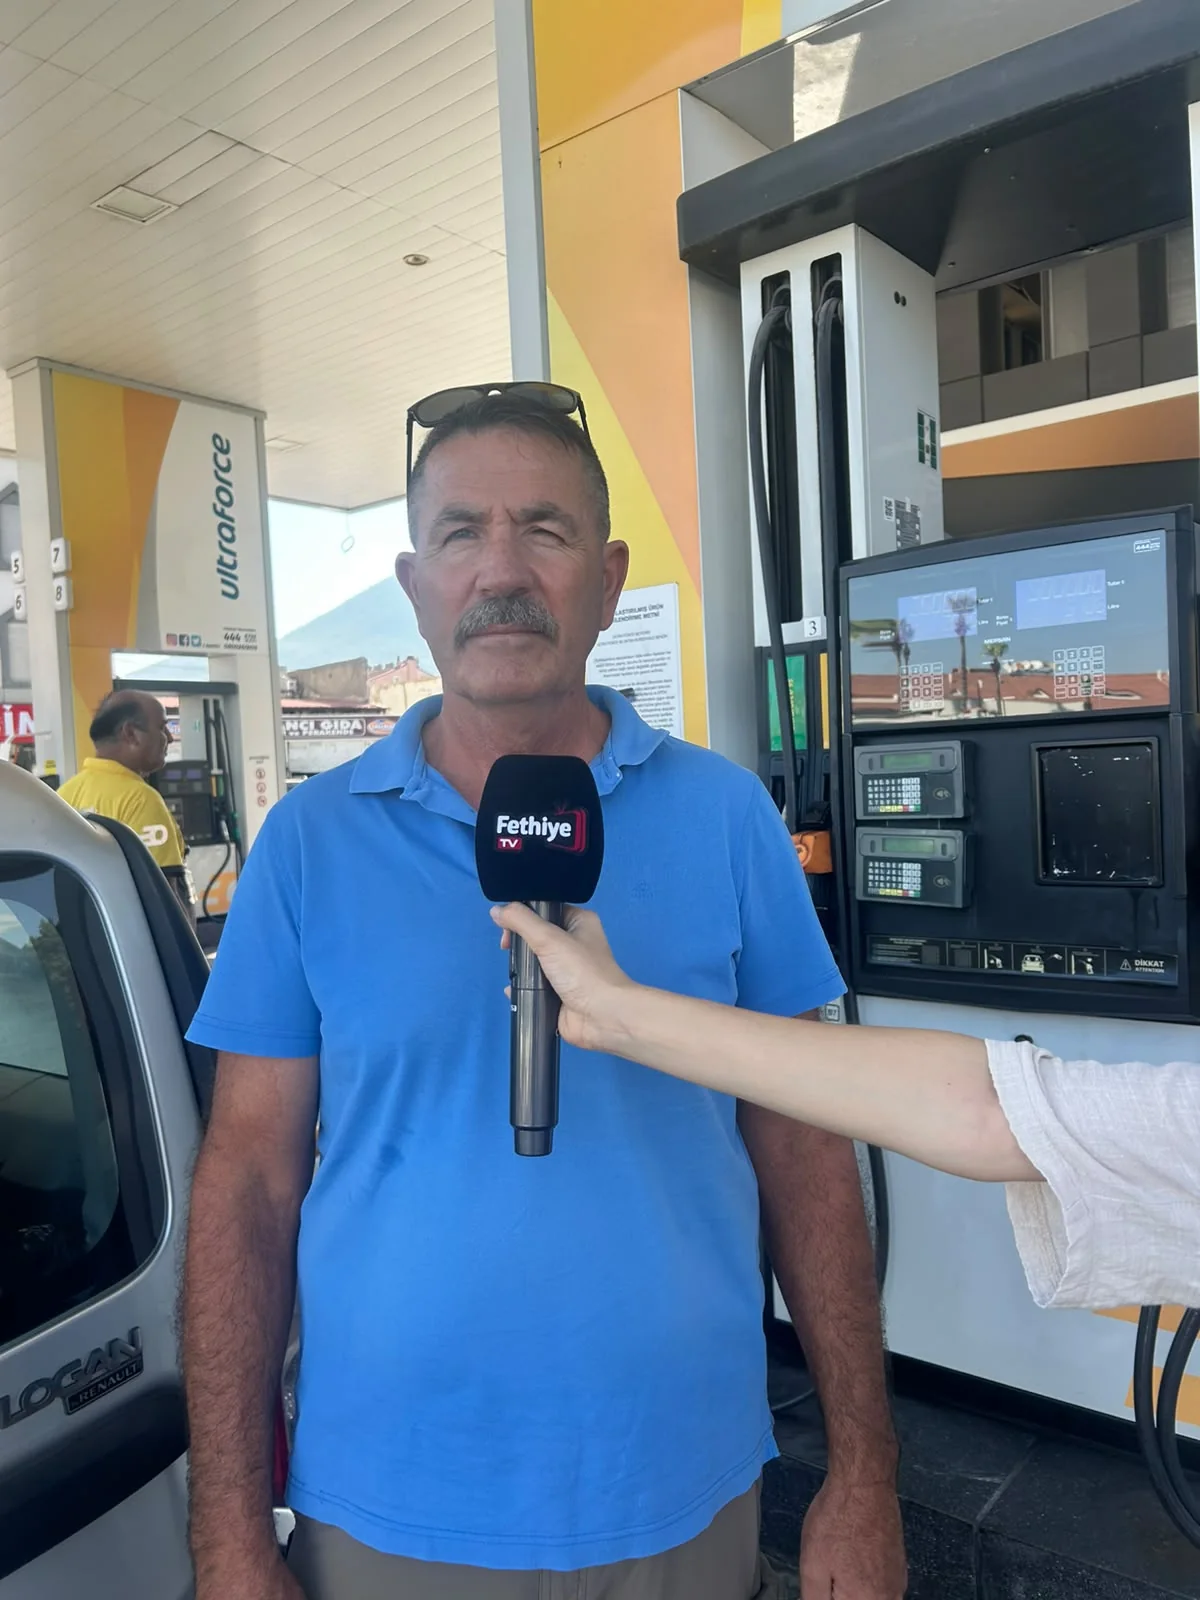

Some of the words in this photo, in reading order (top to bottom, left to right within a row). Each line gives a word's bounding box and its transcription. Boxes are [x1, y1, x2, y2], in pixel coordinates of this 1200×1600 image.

[53, 547, 60, 563] 7
[13, 558, 20, 574] 5
[55, 585, 62, 601] 8
[15, 594, 22, 610] 6
[808, 620, 818, 637] 3
[320, 719, 362, 730] GIDA
[496, 815, 572, 842] Fethiye
[500, 838, 519, 848] TV
[1134, 959, 1165, 968] DİKKAT
[0, 1325, 144, 1430] LOGAN
[79, 1362, 139, 1404] RENAULT
